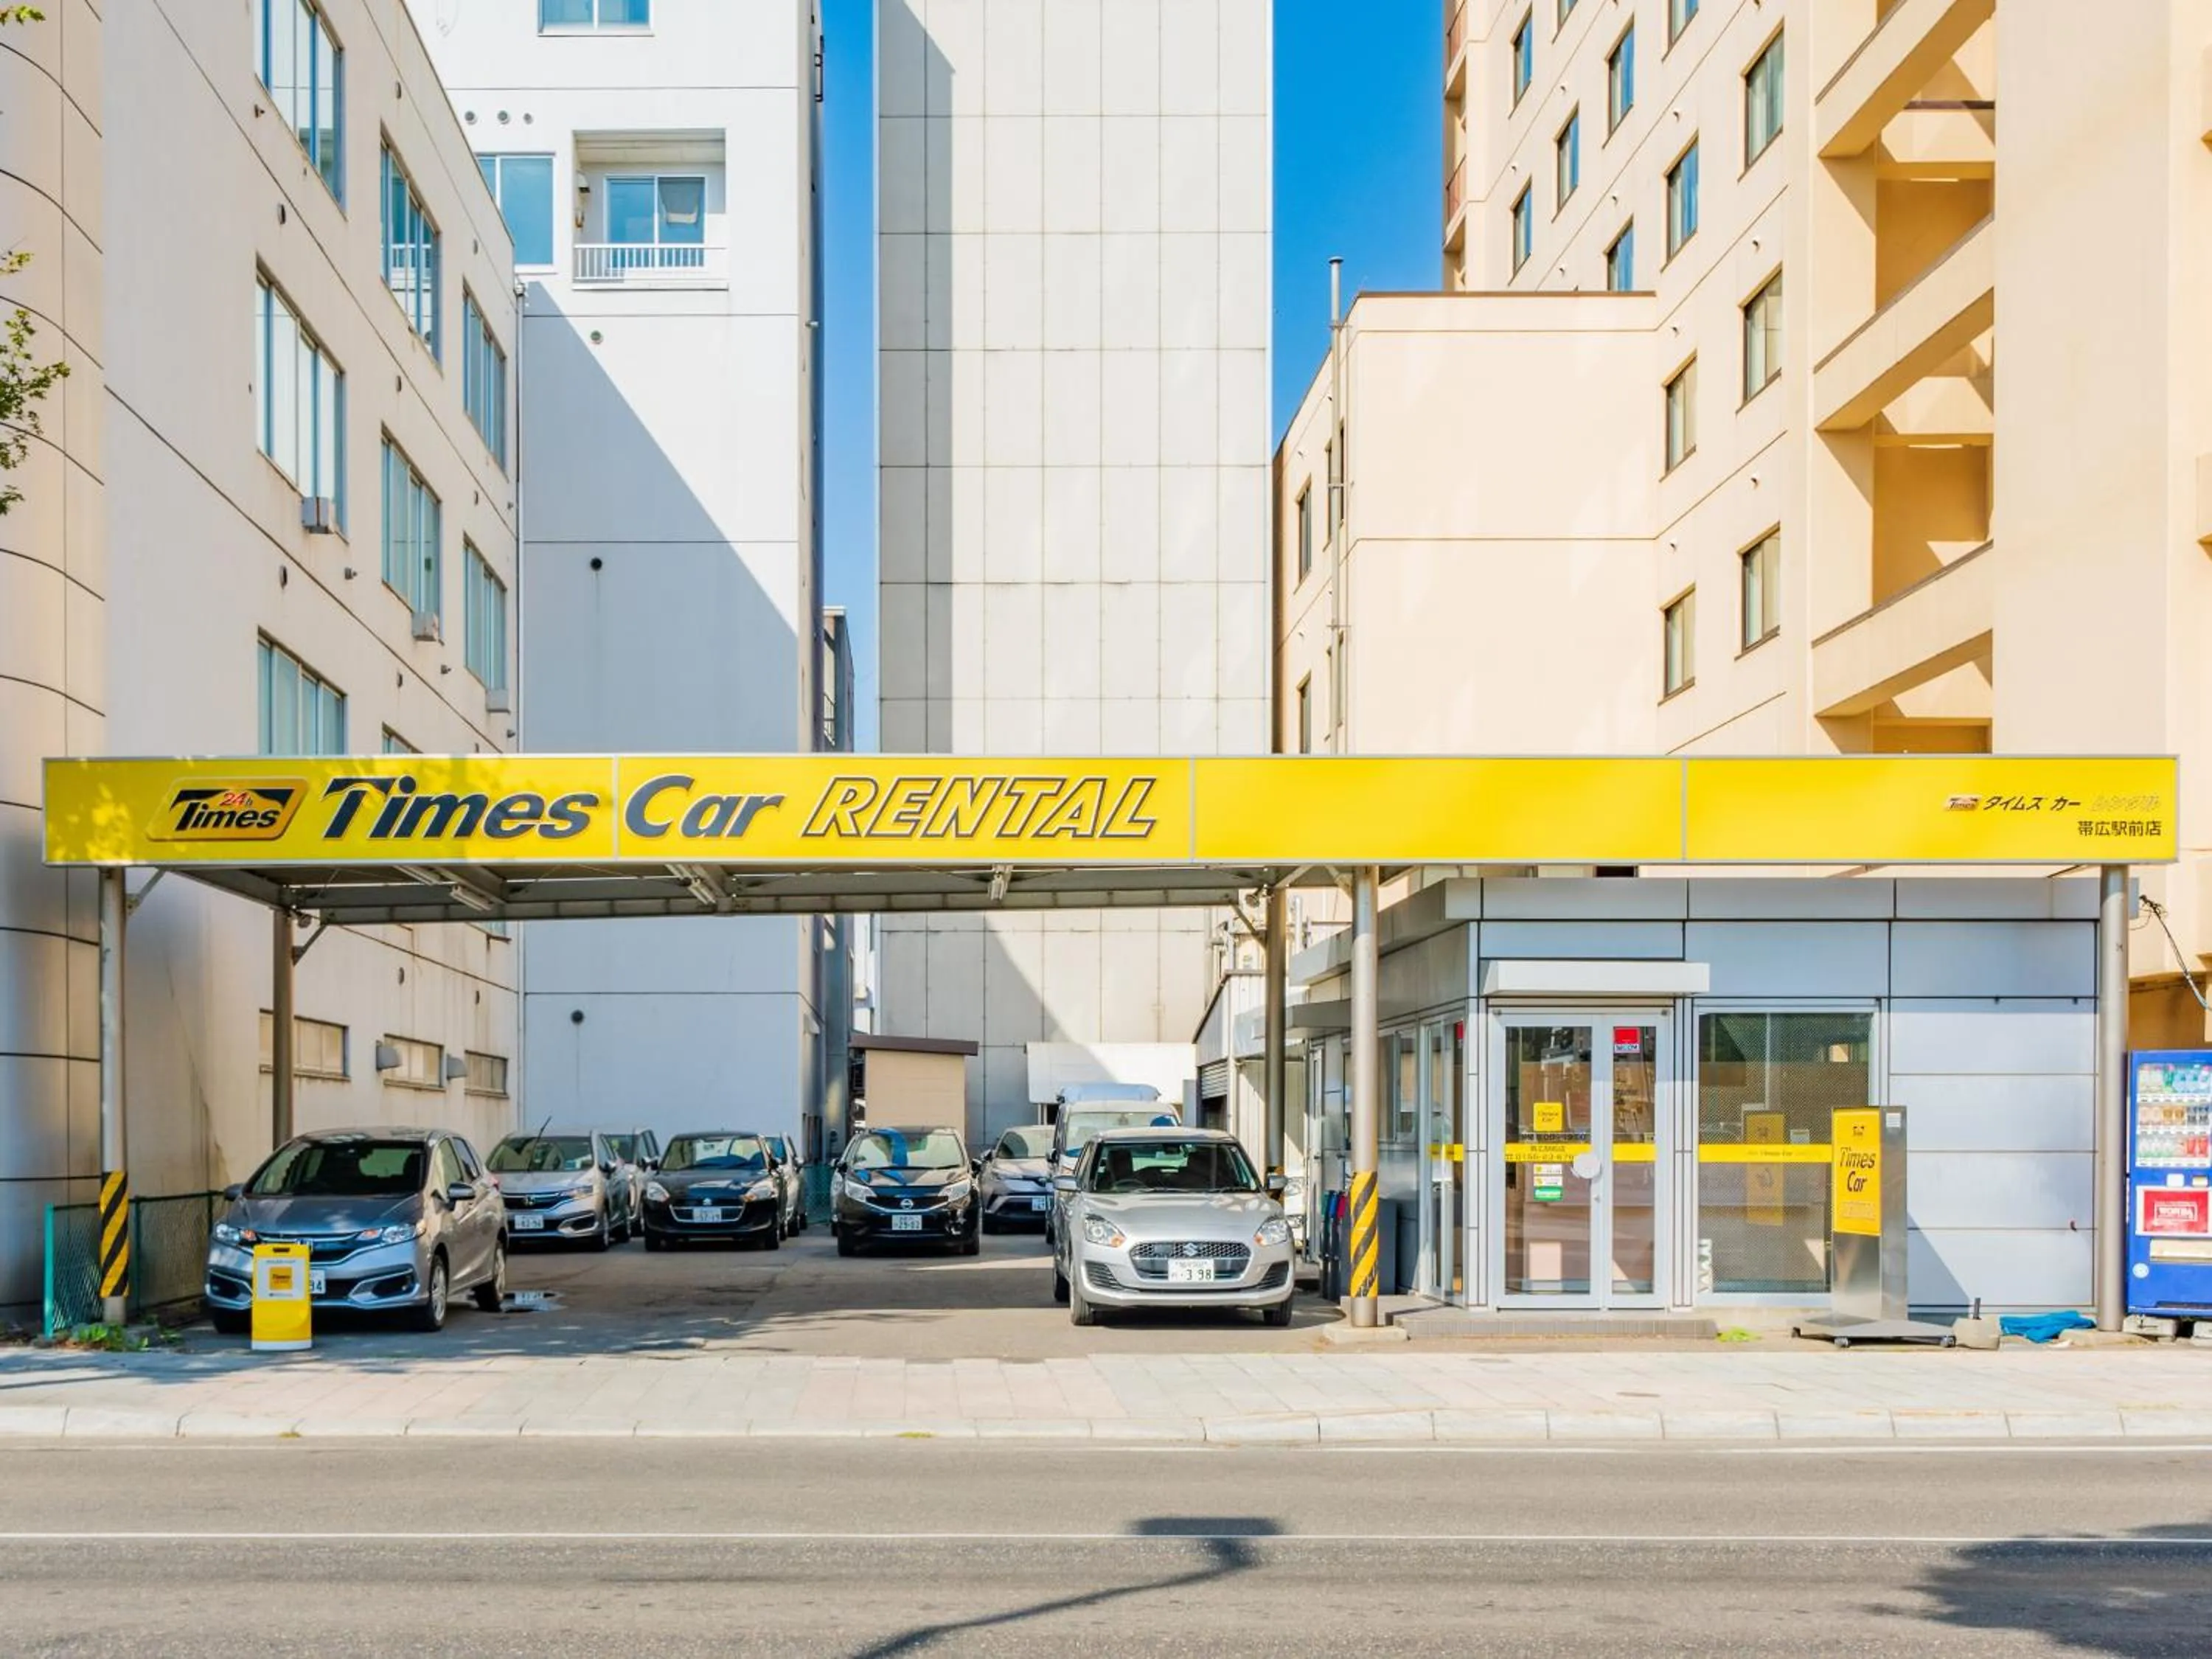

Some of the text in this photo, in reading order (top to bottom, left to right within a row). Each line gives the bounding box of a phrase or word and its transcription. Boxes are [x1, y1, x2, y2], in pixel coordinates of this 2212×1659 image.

[170, 790, 285, 832] Times
[321, 773, 1158, 839] Times Car RENTAL
[2049, 796, 2081, 812] カー
[2077, 821, 2162, 837] 帯広駅前店
[1840, 1147, 1877, 1169] Times
[1846, 1170, 1868, 1193] Car
